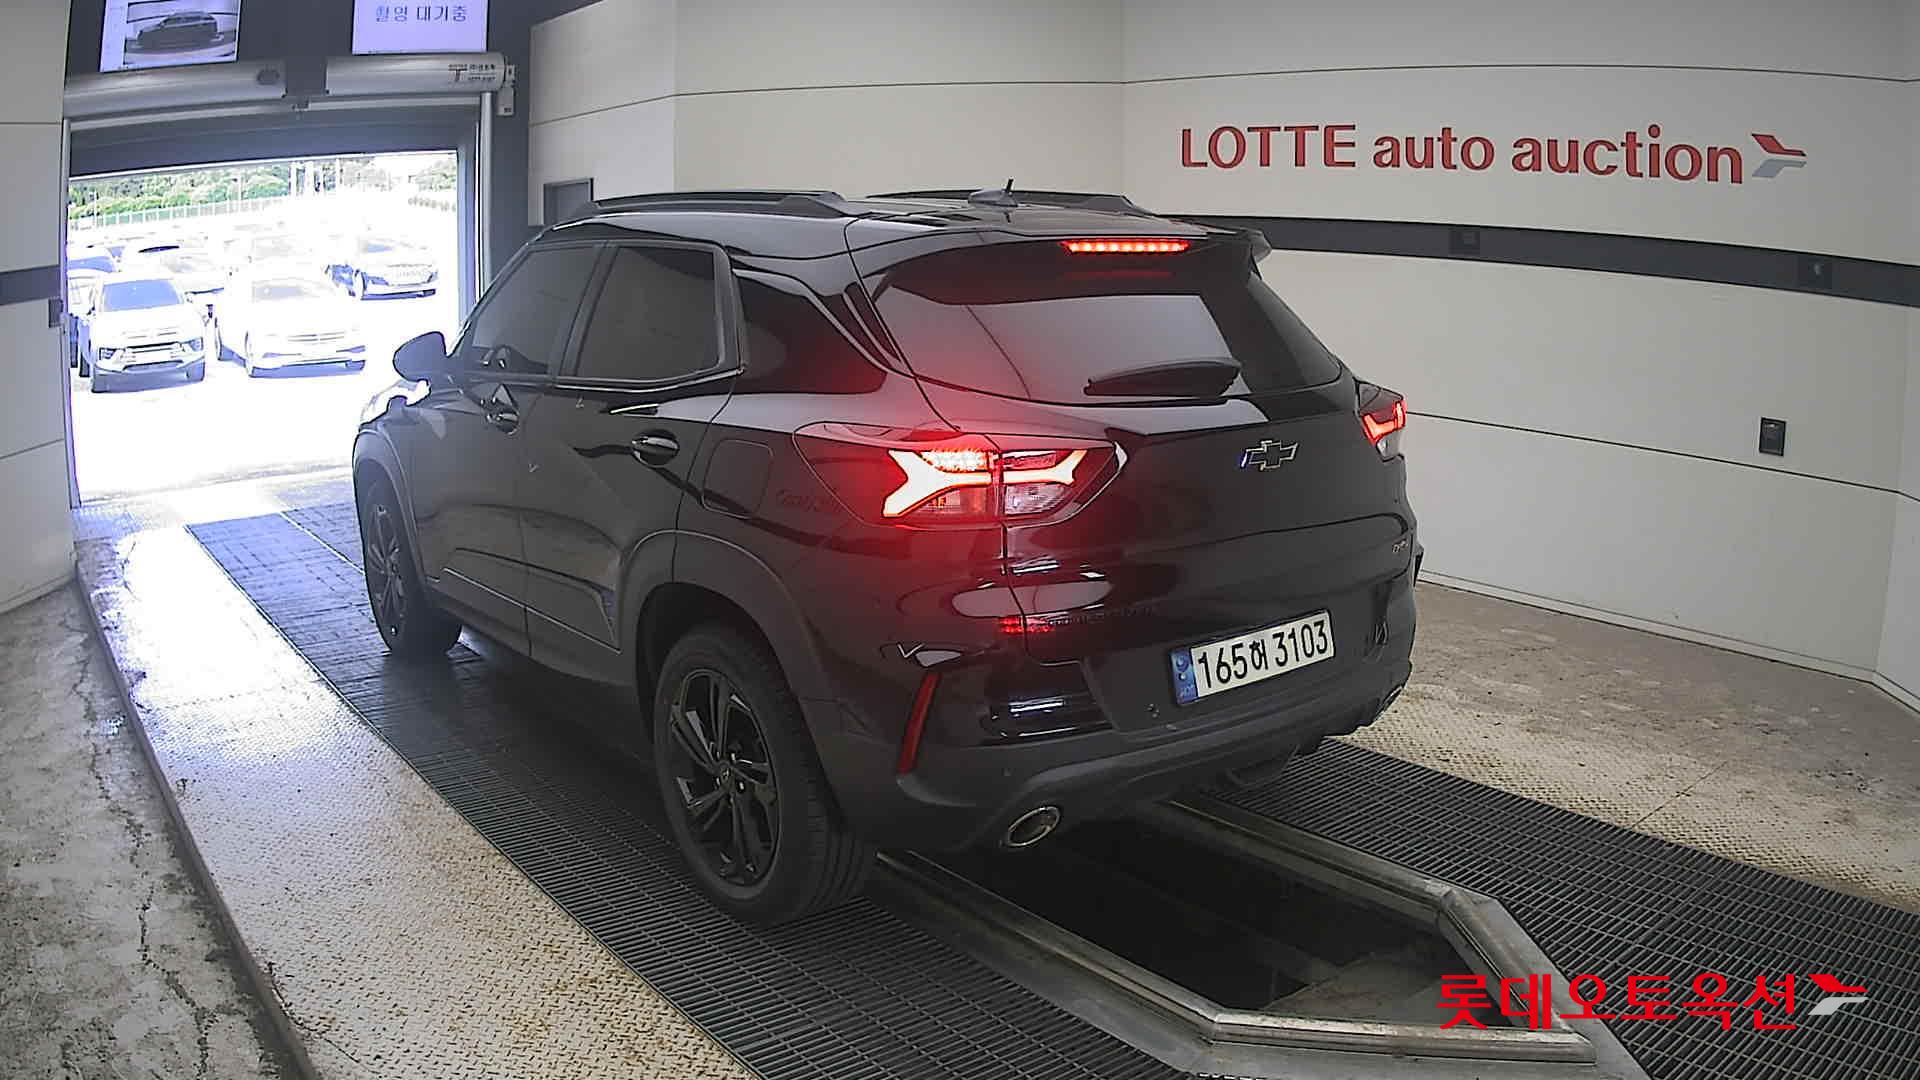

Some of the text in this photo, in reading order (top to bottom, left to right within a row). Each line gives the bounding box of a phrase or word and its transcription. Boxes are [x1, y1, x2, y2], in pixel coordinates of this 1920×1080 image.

[1181, 124, 1744, 184] LOTTE auto auction
[1198, 619, 1328, 688] 165허 3103
